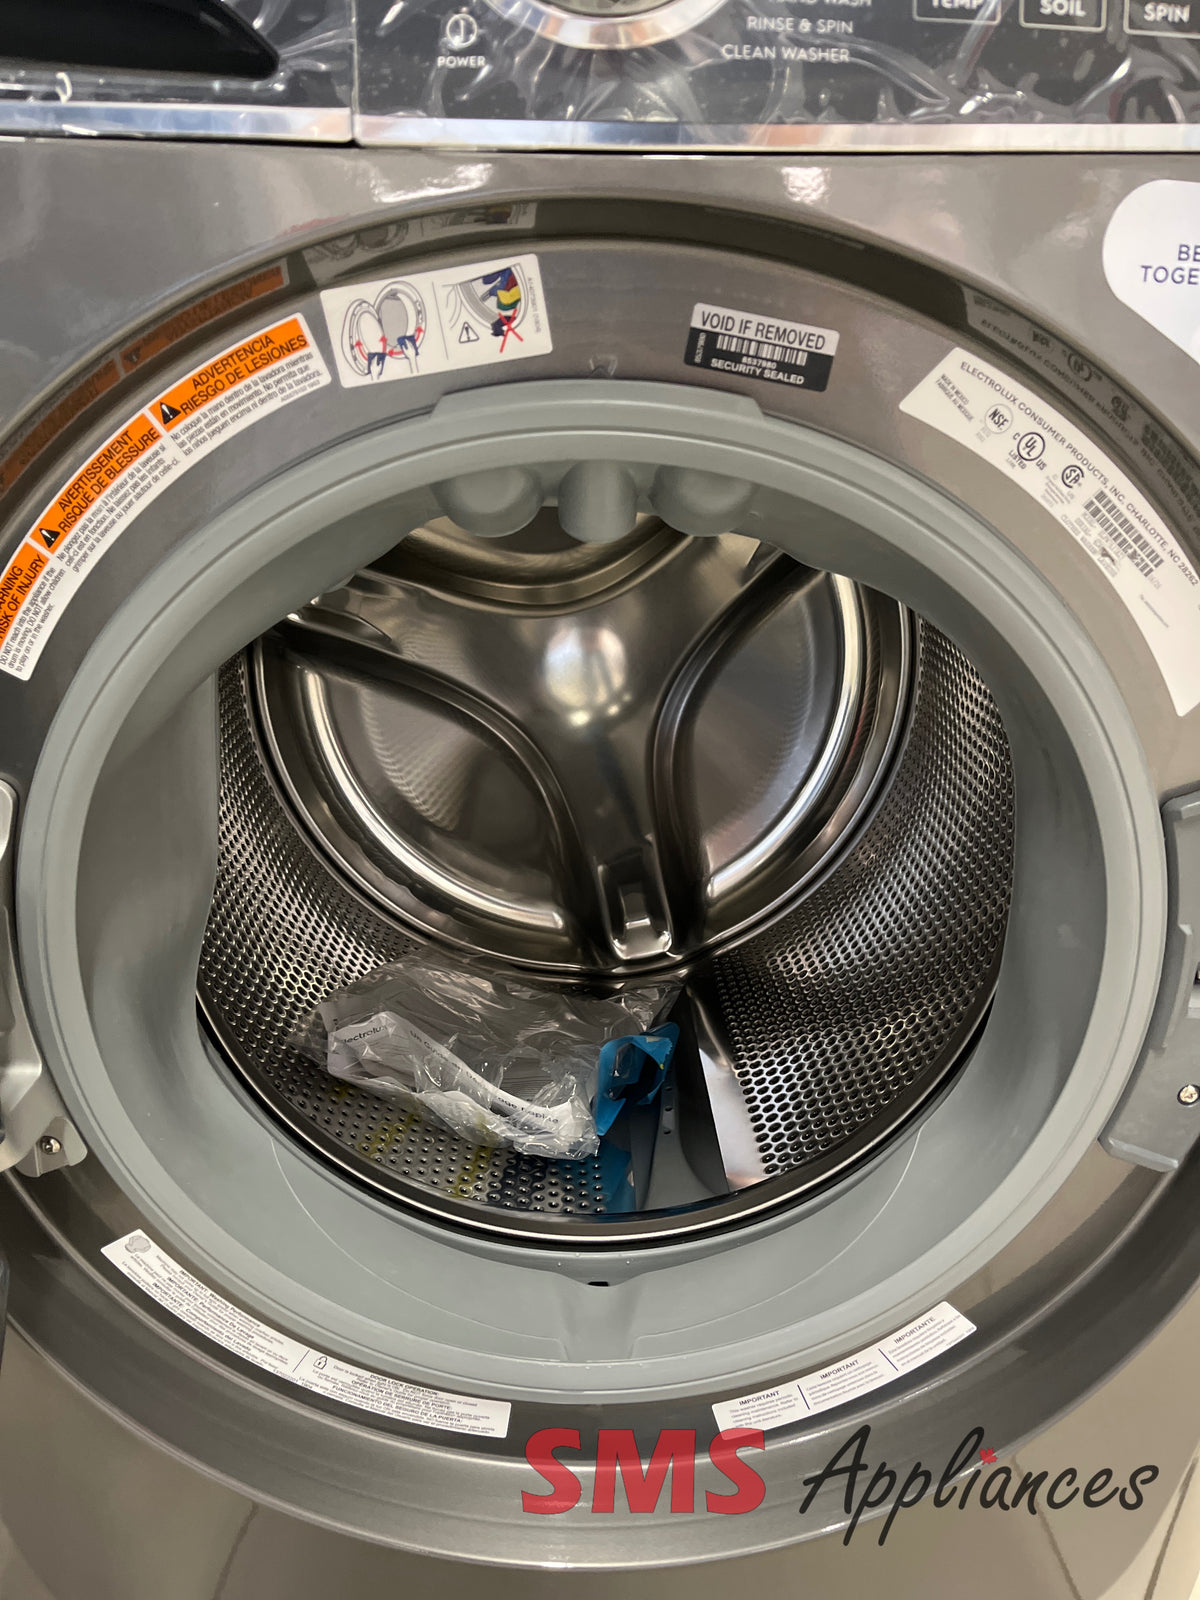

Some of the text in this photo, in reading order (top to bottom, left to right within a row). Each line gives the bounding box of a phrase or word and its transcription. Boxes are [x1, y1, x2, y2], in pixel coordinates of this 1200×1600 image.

[1039, 0, 1086, 16] SOIL
[1143, 2, 1190, 22] SPIN
[746, 16, 854, 34] RINSE & SPIN
[436, 55, 485, 68] POWER
[722, 44, 850, 63] CLEAN WASHER
[699, 310, 826, 351] VOID IF REMOVED
[191, 335, 275, 390] ADVERTENCIA
[710, 357, 804, 385] SECURITY SEALED
[179, 334, 307, 415] RIESGO DE LESIONES
[56, 430, 135, 511] AVERTISSEMENT
[89, 476, 108, 495] DE
[103, 427, 160, 480] BLESSURE
[960, 361, 1017, 405] ELECTROLUX
[1018, 402, 1066, 446] CONSUMER
[1168, 548, 1181, 563] NC
[1008, 450, 1027, 470] LISTED
[1036, 459, 1048, 471] US
[5, 593, 22, 612] OF
[17, 554, 46, 594] INJURY
[894, 1316, 935, 1344] IMPORTANTE
[369, 1373, 386, 1382] DOOR
[387, 1378, 404, 1387] LOCK
[820, 1359, 859, 1380] IMPORTANT
[739, 1390, 780, 1406] IMPORTANT
